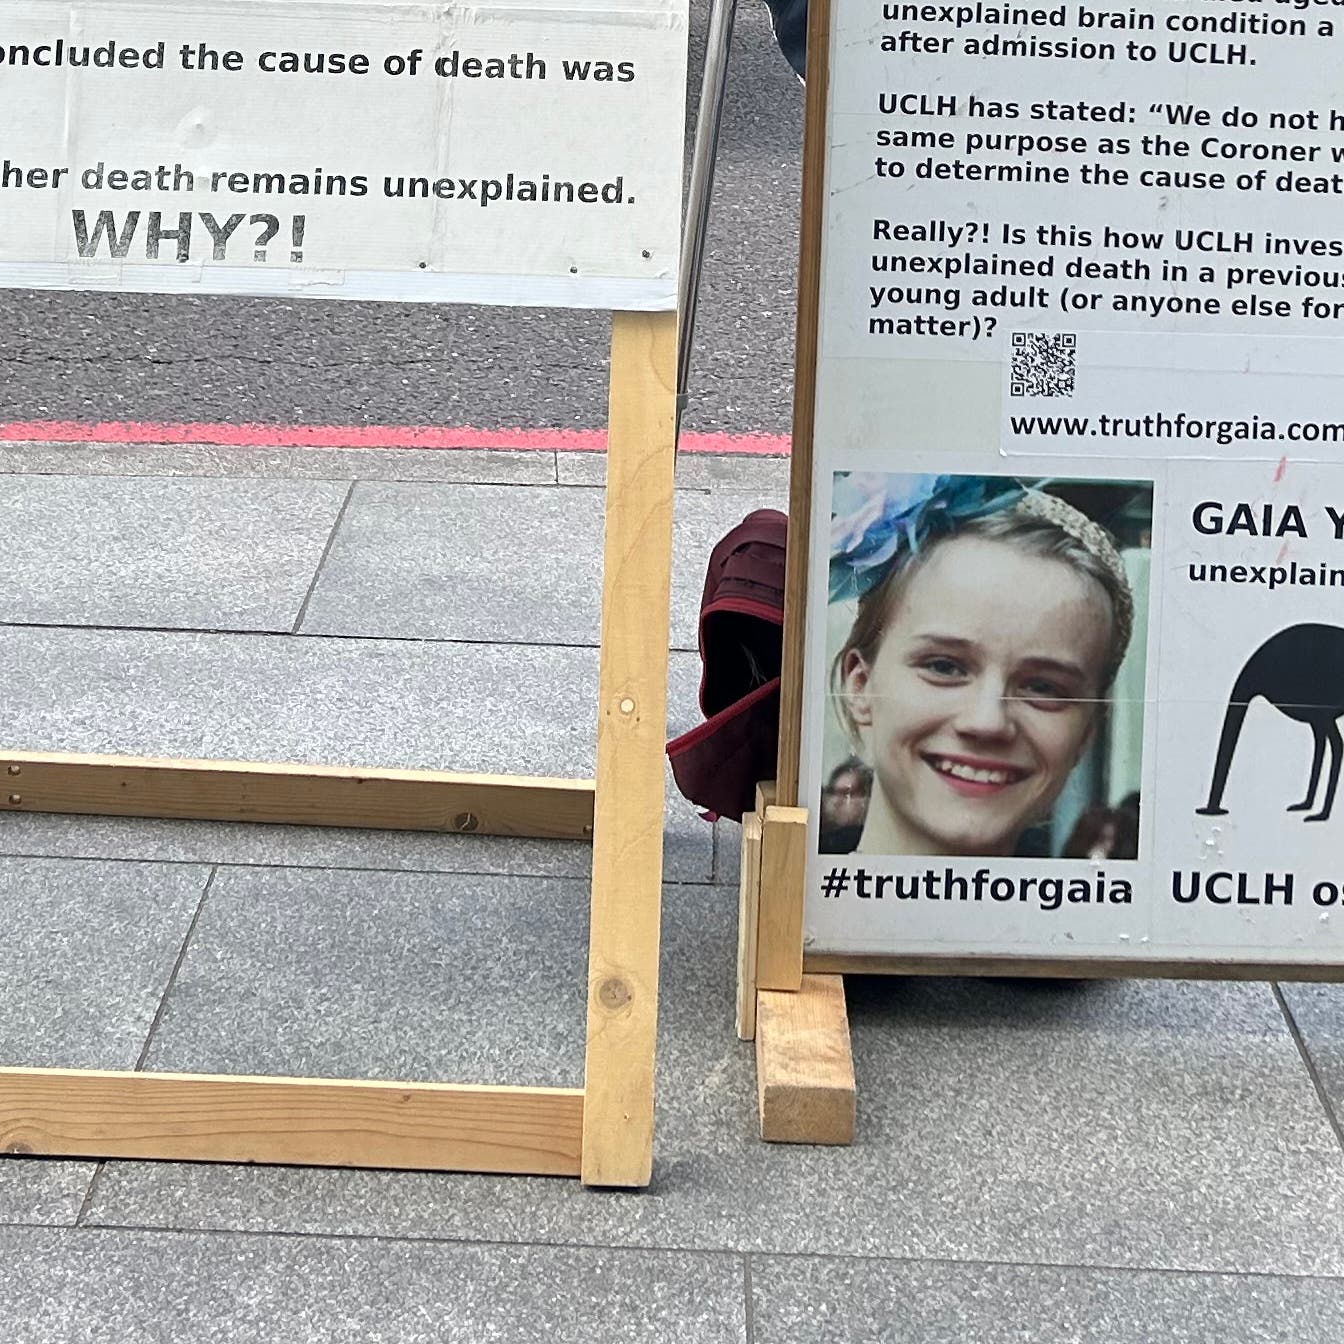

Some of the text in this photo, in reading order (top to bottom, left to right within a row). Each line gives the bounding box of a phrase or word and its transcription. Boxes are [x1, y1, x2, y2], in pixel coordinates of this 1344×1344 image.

[883, 2, 1066, 28] unexplained
[1078, 6, 1154, 30] brain
[1166, 12, 1306, 35] condition
[1317, 21, 1334, 37] a
[179, 43, 243, 71] the
[259, 52, 369, 74] cause
[384, 49, 423, 75] of
[435, 53, 545, 79] death
[562, 61, 635, 82] was
[881, 31, 1256, 65] after admission to UCLH.
[879, 93, 956, 116] UCLH
[968, 96, 1019, 119] has
[1030, 100, 1136, 123] stated:
[1222, 106, 1258, 128] do
[1269, 110, 1319, 130] not
[877, 130, 955, 148] same
[966, 133, 1087, 156] purpose
[1098, 138, 1130, 154] as
[1140, 135, 1190, 157] the
[1201, 137, 1321, 162] Coroner
[2, 160, 68, 188] her
[82, 162, 193, 191] death
[211, 168, 367, 196] remains
[384, 173, 635, 207] unexplained.
[875, 157, 905, 177] to
[915, 157, 1069, 184] determine
[1080, 163, 1129, 185] the
[1140, 171, 1225, 189] cause
[1236, 170, 1267, 191] of
[72, 210, 305, 263] WHY?!
[874, 220, 989, 248] Really?!
[1003, 224, 1025, 245] Is
[1036, 224, 1092, 247] this
[1104, 226, 1164, 250] how
[1176, 230, 1253, 253] UCLH
[872, 251, 1054, 280] unexplained
[1066, 256, 1150, 280] death
[1162, 260, 1187, 282] in
[1199, 267, 1214, 283] a
[870, 287, 960, 311] young
[972, 285, 1049, 309] adult
[1060, 287, 1104, 313] (or
[1112, 289, 1221, 317] anyone
[1232, 294, 1291, 317] else
[869, 314, 997, 340] matter)?
[1193, 502, 1308, 539] GAIA
[821, 868, 1132, 911] #truthforgaia
[1173, 871, 1293, 906] UCLH
